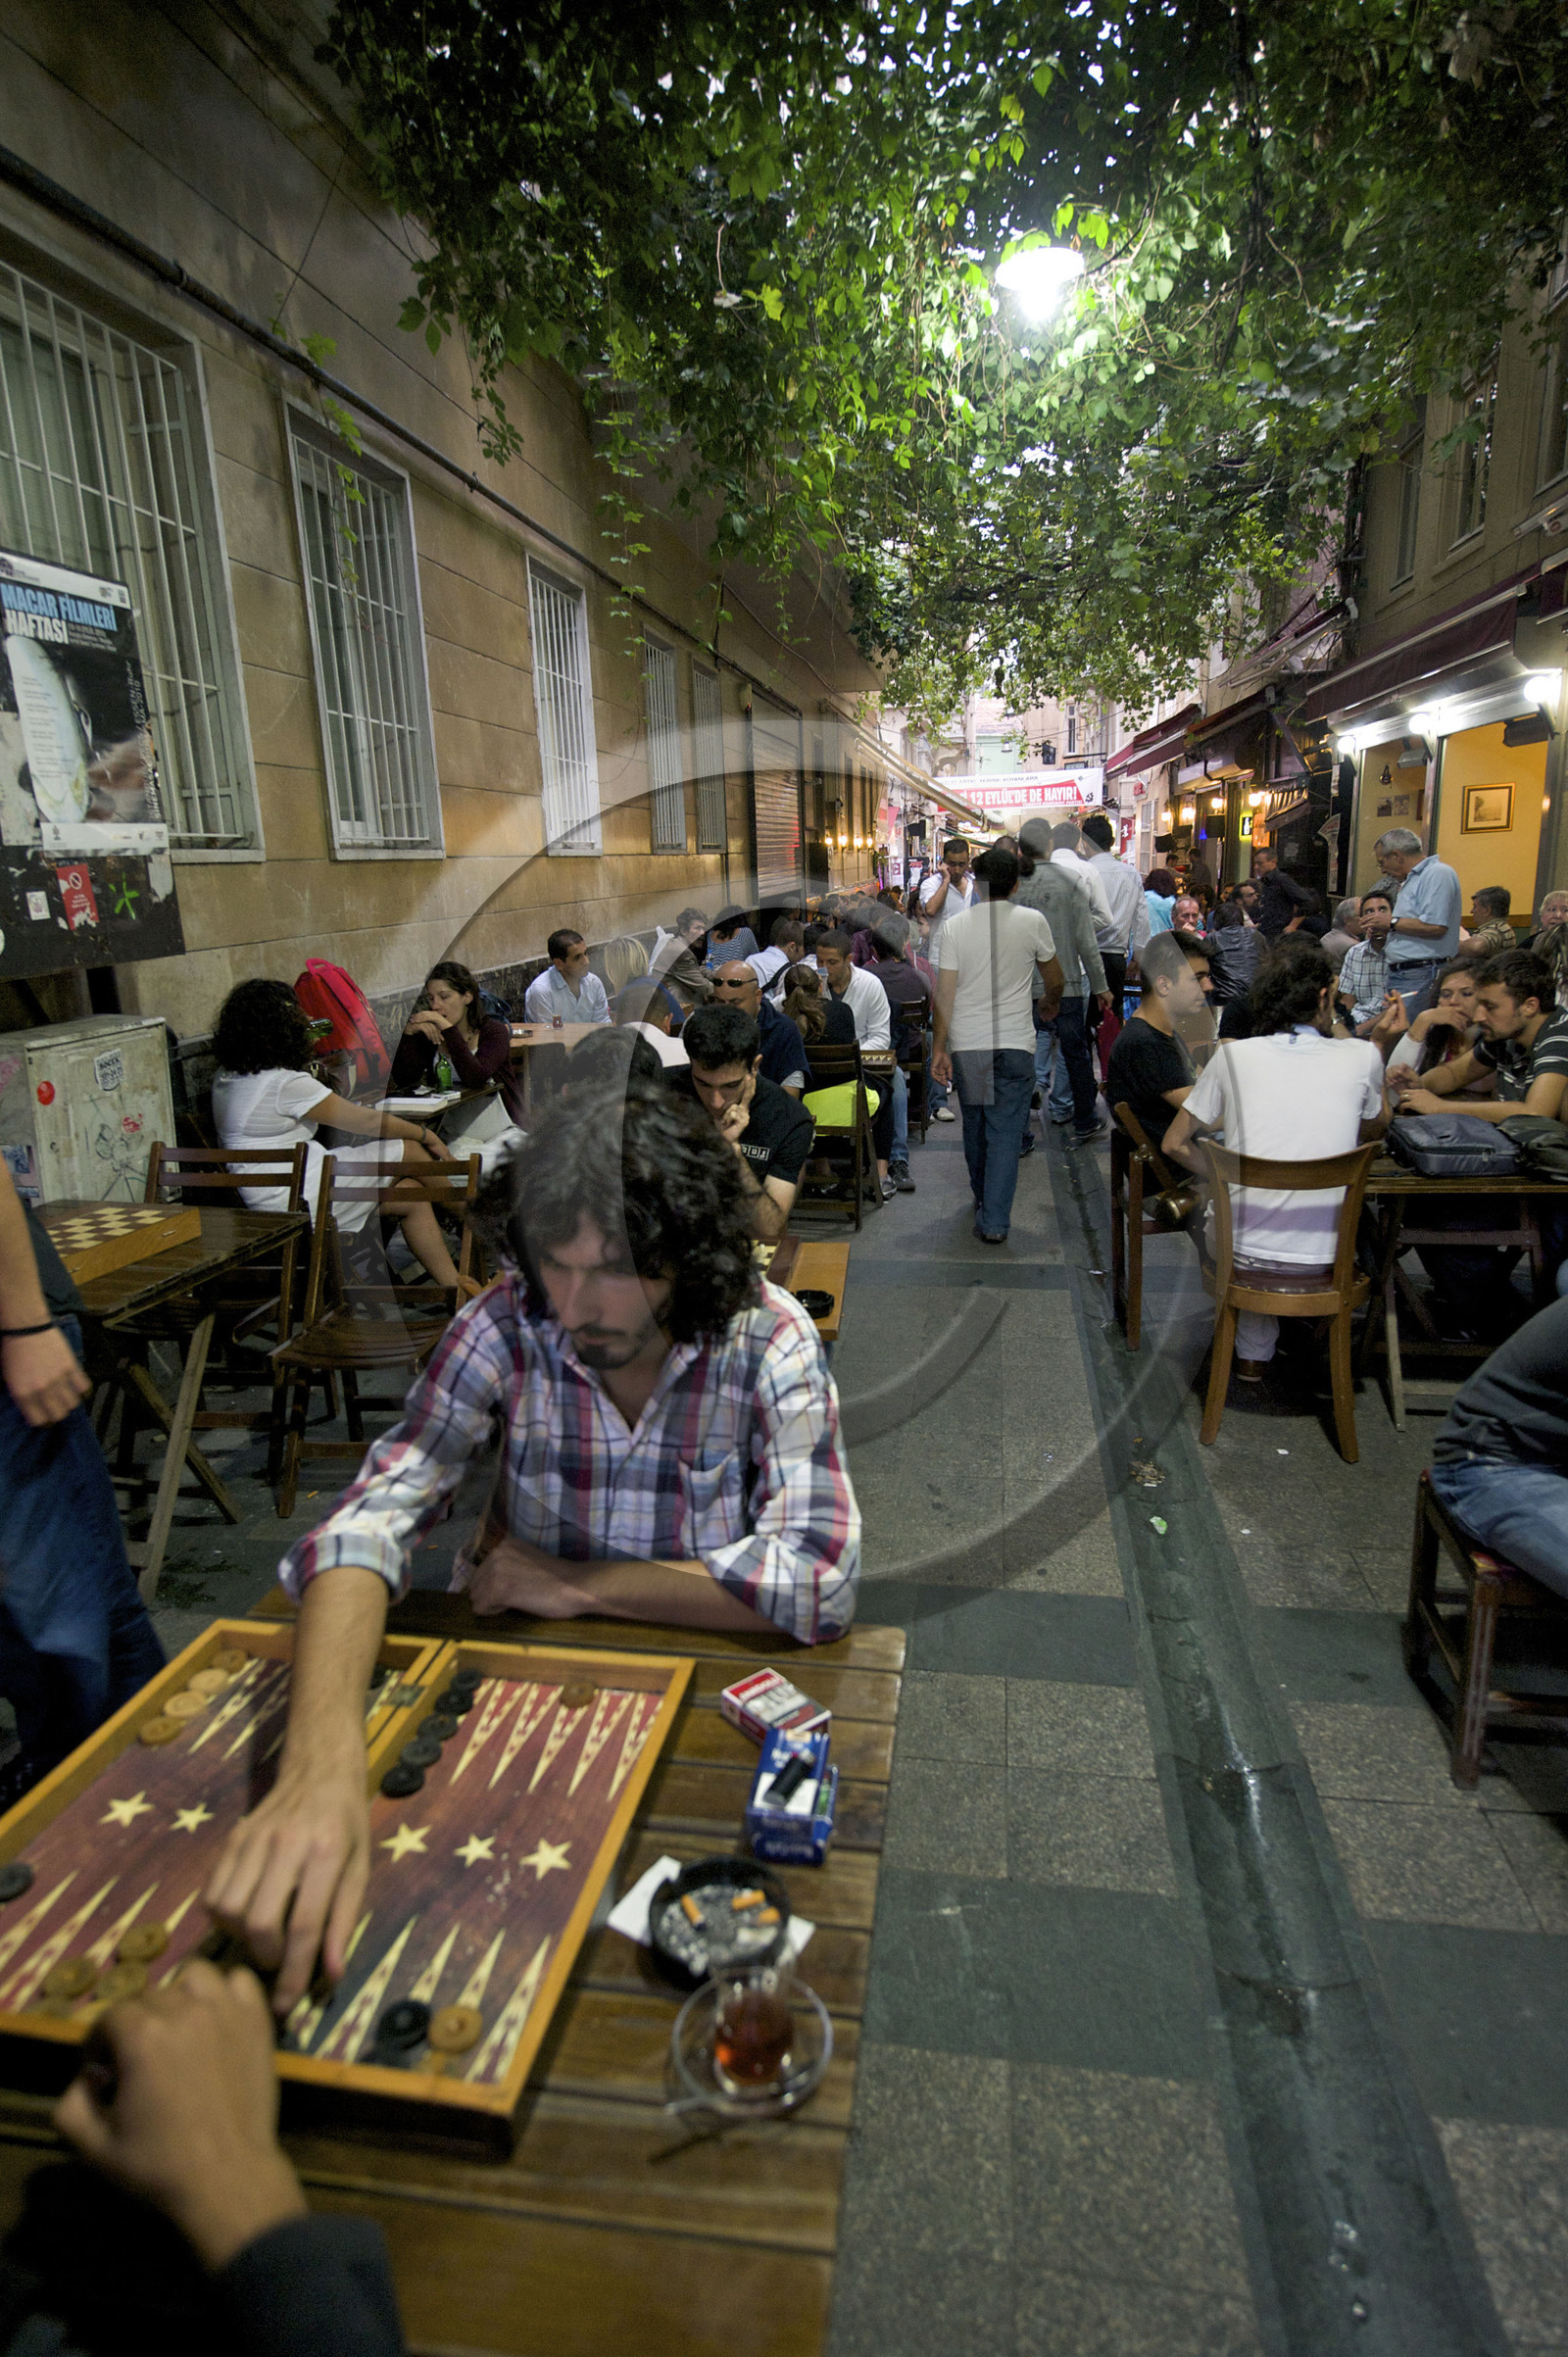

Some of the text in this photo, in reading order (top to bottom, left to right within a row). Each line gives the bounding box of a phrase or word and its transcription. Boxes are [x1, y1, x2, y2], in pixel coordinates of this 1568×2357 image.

[0, 582, 59, 618] MACAR
[59, 593, 118, 632] FİLMLERİ
[5, 609, 70, 644] HAFTASI
[969, 790, 984, 806] 12
[985, 787, 1028, 806] EYLÜL'DE
[1029, 787, 1043, 803] DE
[1044, 785, 1078, 801] HAYIR!
